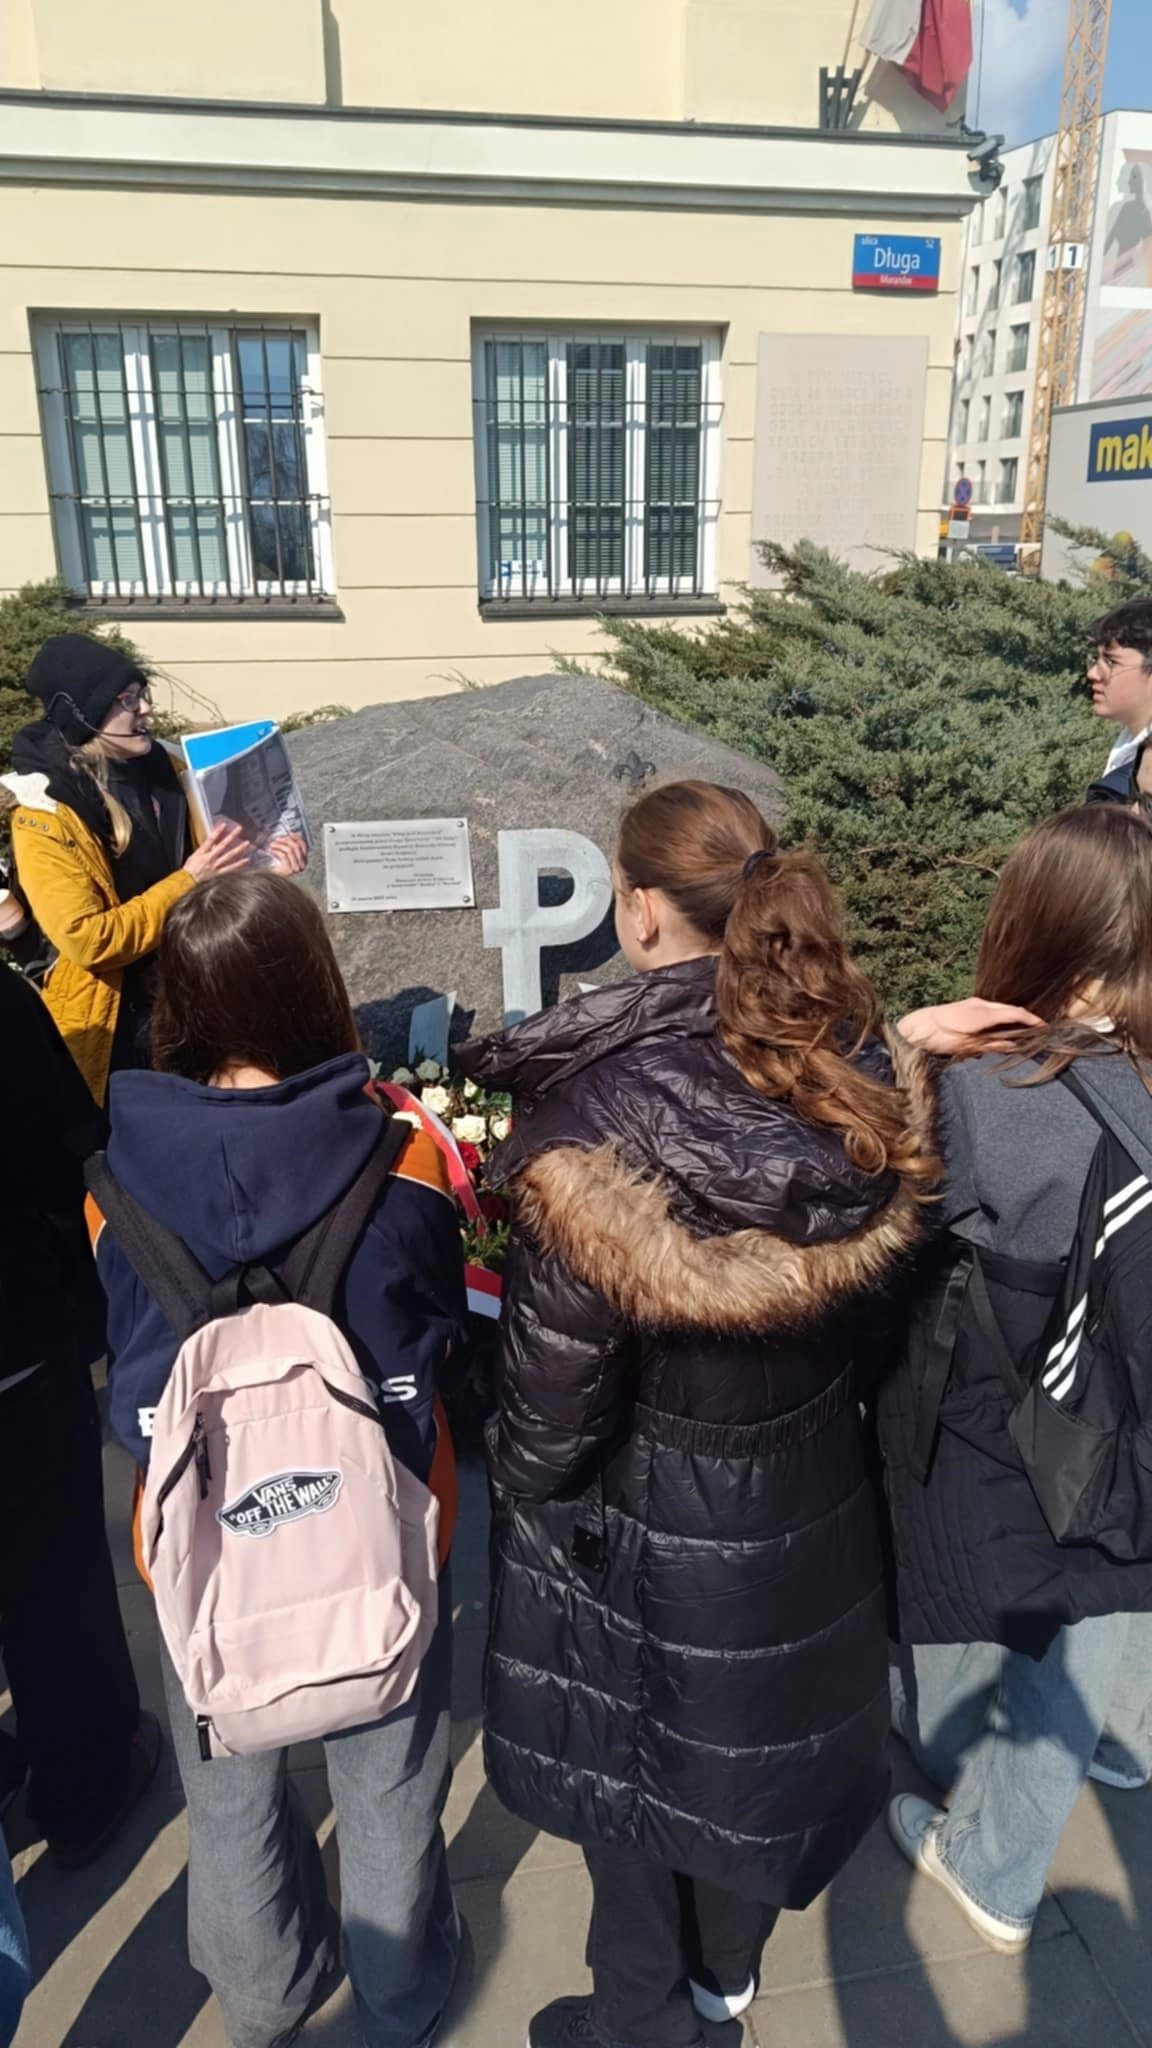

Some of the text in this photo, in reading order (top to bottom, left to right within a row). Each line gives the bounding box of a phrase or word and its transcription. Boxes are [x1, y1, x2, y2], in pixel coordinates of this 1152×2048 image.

[873, 246, 921, 274] Długa
[252, 1480, 298, 1507] VANS
[263, 1493, 297, 1517] THE
